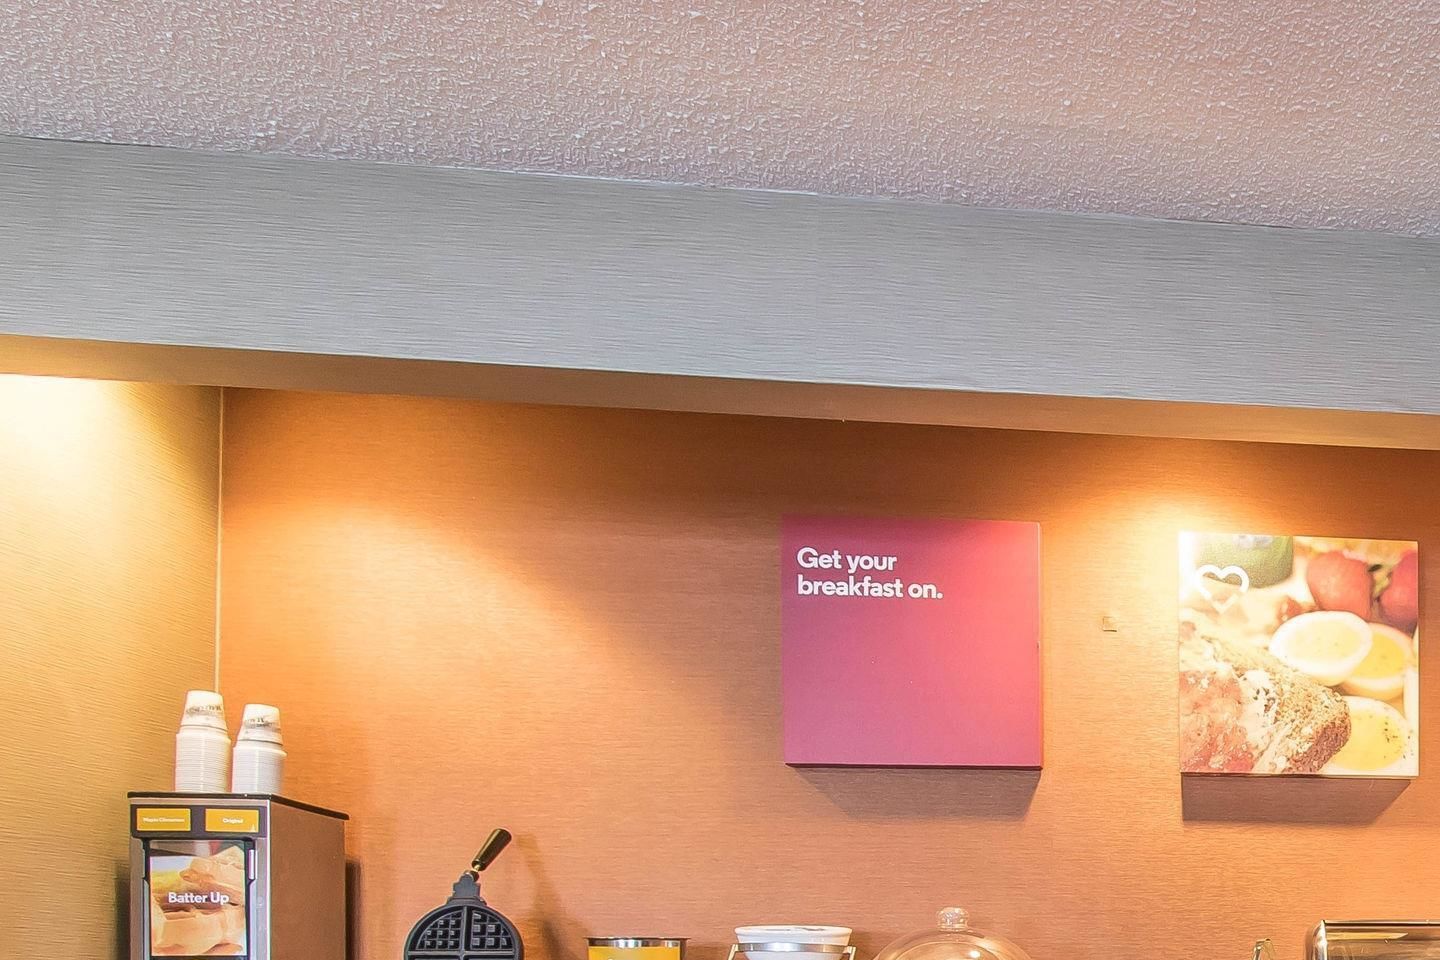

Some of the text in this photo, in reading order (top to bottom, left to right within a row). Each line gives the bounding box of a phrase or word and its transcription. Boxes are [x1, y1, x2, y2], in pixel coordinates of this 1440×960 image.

[796, 546, 897, 574] Get your
[797, 574, 944, 599] breakfast on.
[168, 892, 230, 905] Batter Up
